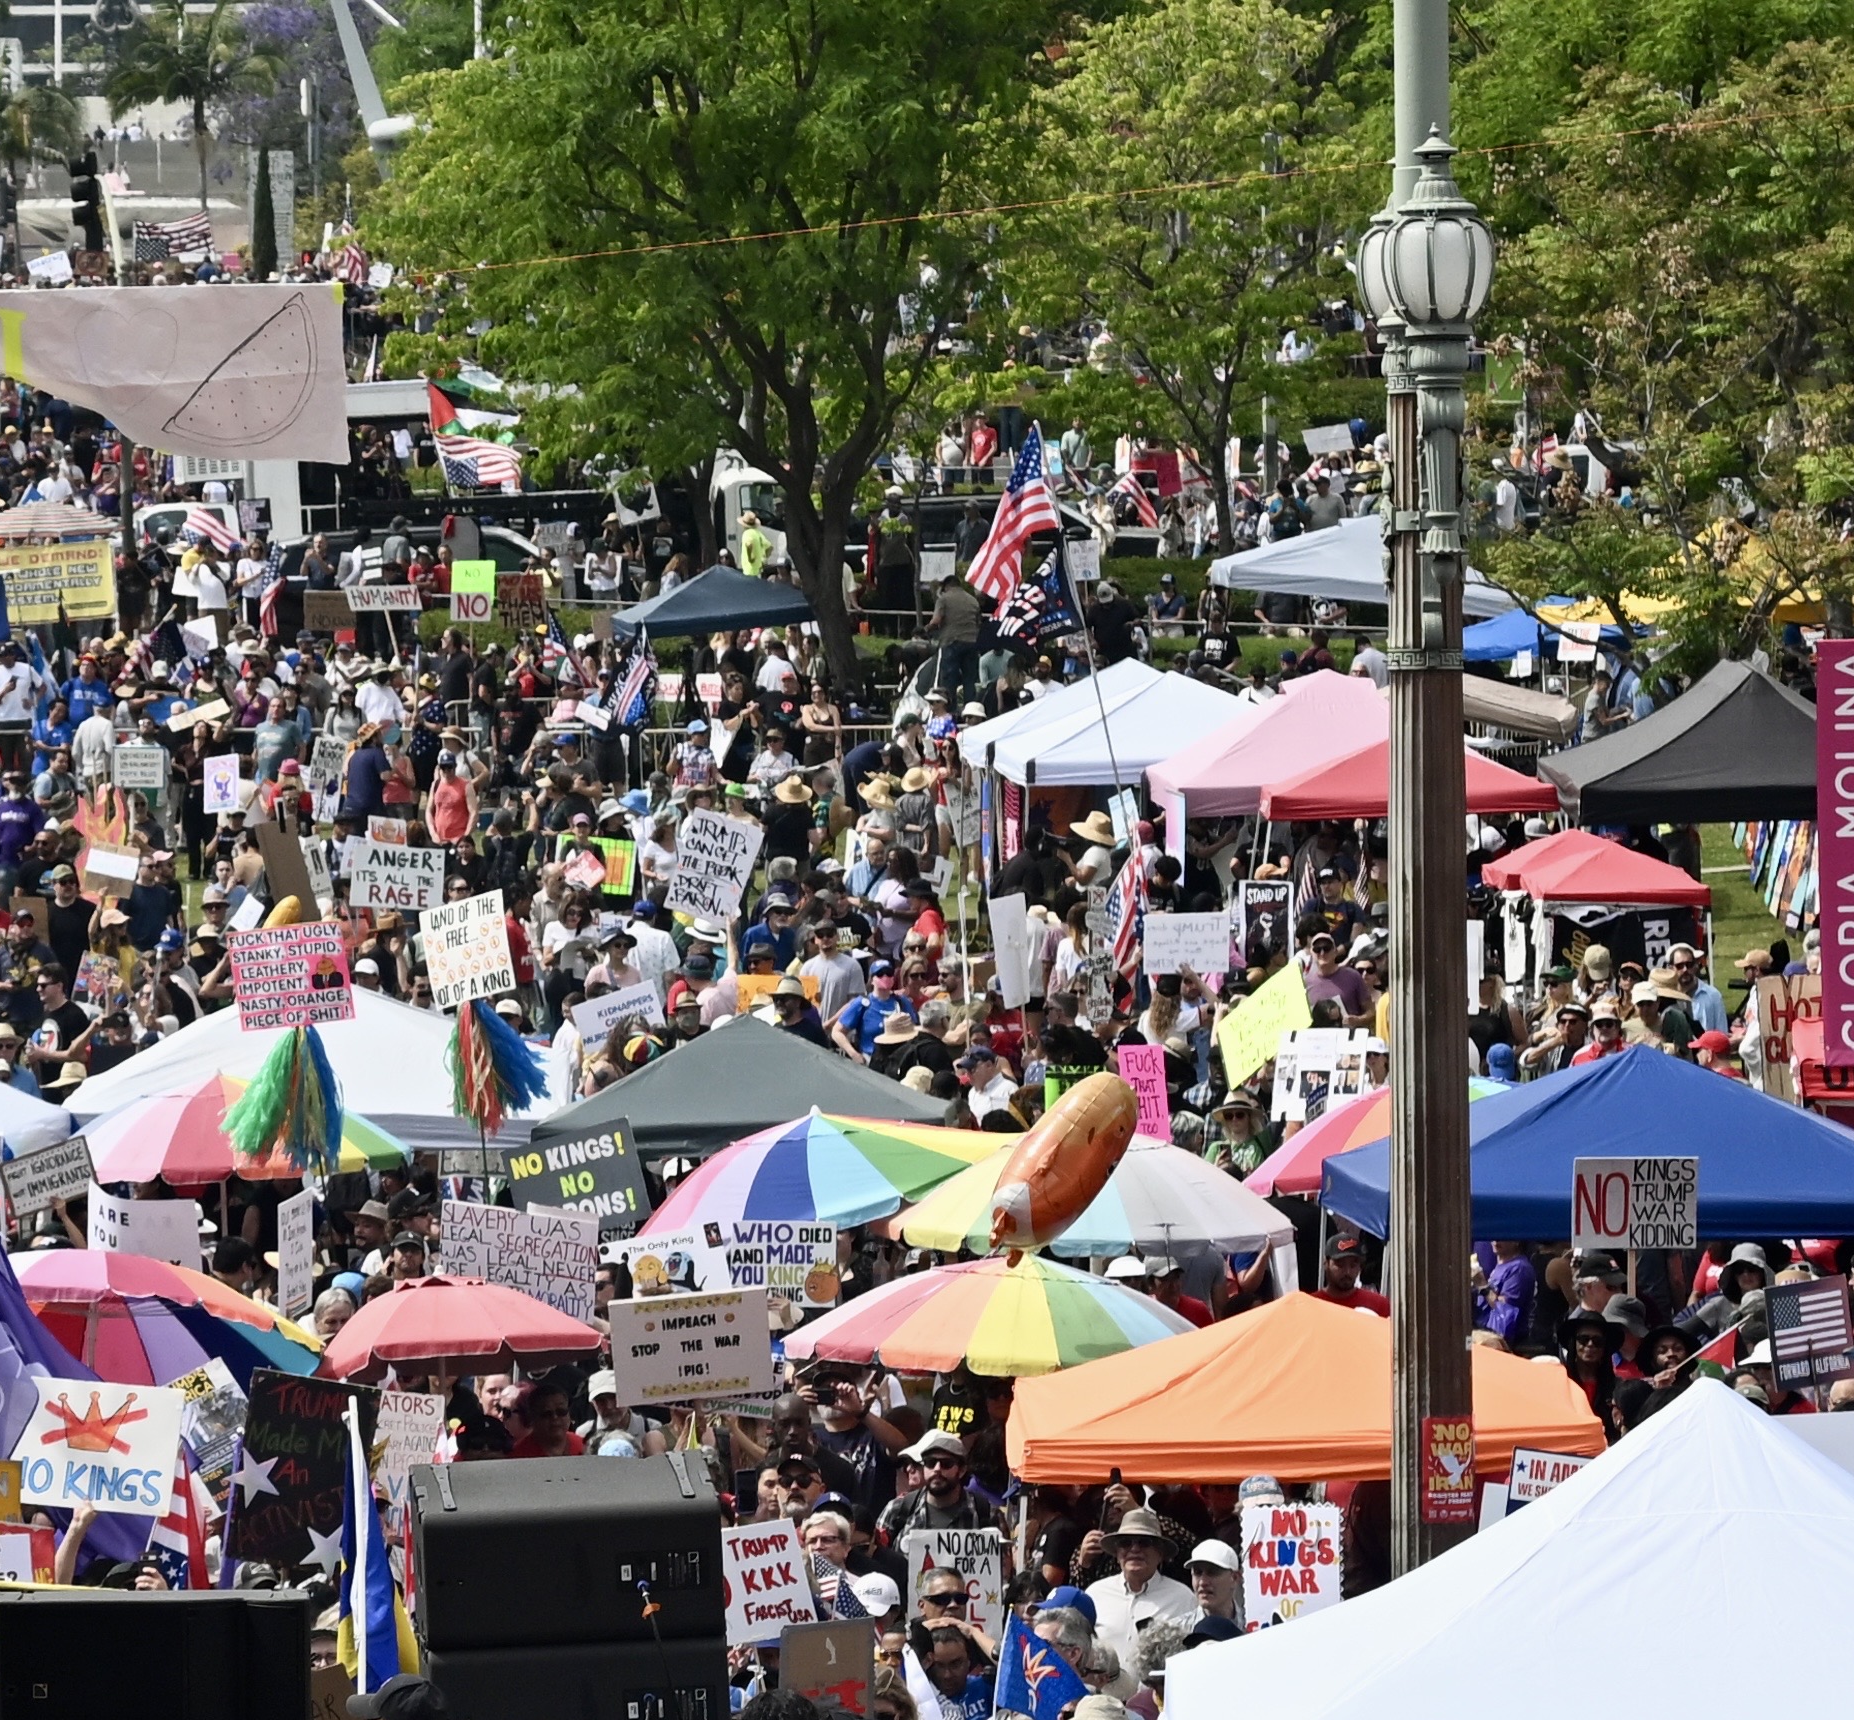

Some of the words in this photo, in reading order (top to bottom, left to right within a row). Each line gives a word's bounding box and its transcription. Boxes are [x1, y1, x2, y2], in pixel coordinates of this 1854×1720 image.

[351, 586, 419, 609] HUMANITY
[385, 874, 410, 886] ALL
[416, 876, 434, 888] THE
[368, 886, 428, 907] RAGE
[228, 933, 265, 948] FUCK
[266, 929, 299, 944] THAT
[245, 1012, 283, 1028] PIECE
[286, 1011, 303, 1022] OF
[510, 1154, 543, 1181] NO
[547, 1131, 625, 1172] KINGS!
[560, 1171, 594, 1198] NO
[1633, 1181, 1696, 1202] TRUMP
[1574, 1170, 1629, 1239] NO
[1633, 1159, 1696, 1183] KINGS
[1633, 1202, 1688, 1222] WAR
[733, 1223, 794, 1243] WHO
[798, 1227, 832, 1244] DIED
[1629, 1223, 1696, 1248] KIDDING
[732, 1249, 764, 1264] AND
[767, 1244, 814, 1264] MADE
[731, 1266, 764, 1286] YOU
[767, 1265, 805, 1286] KING
[662, 1314, 717, 1331] IMPEACH
[631, 1343, 660, 1358] STOP
[681, 1339, 703, 1353] THE
[715, 1335, 740, 1349] WAR
